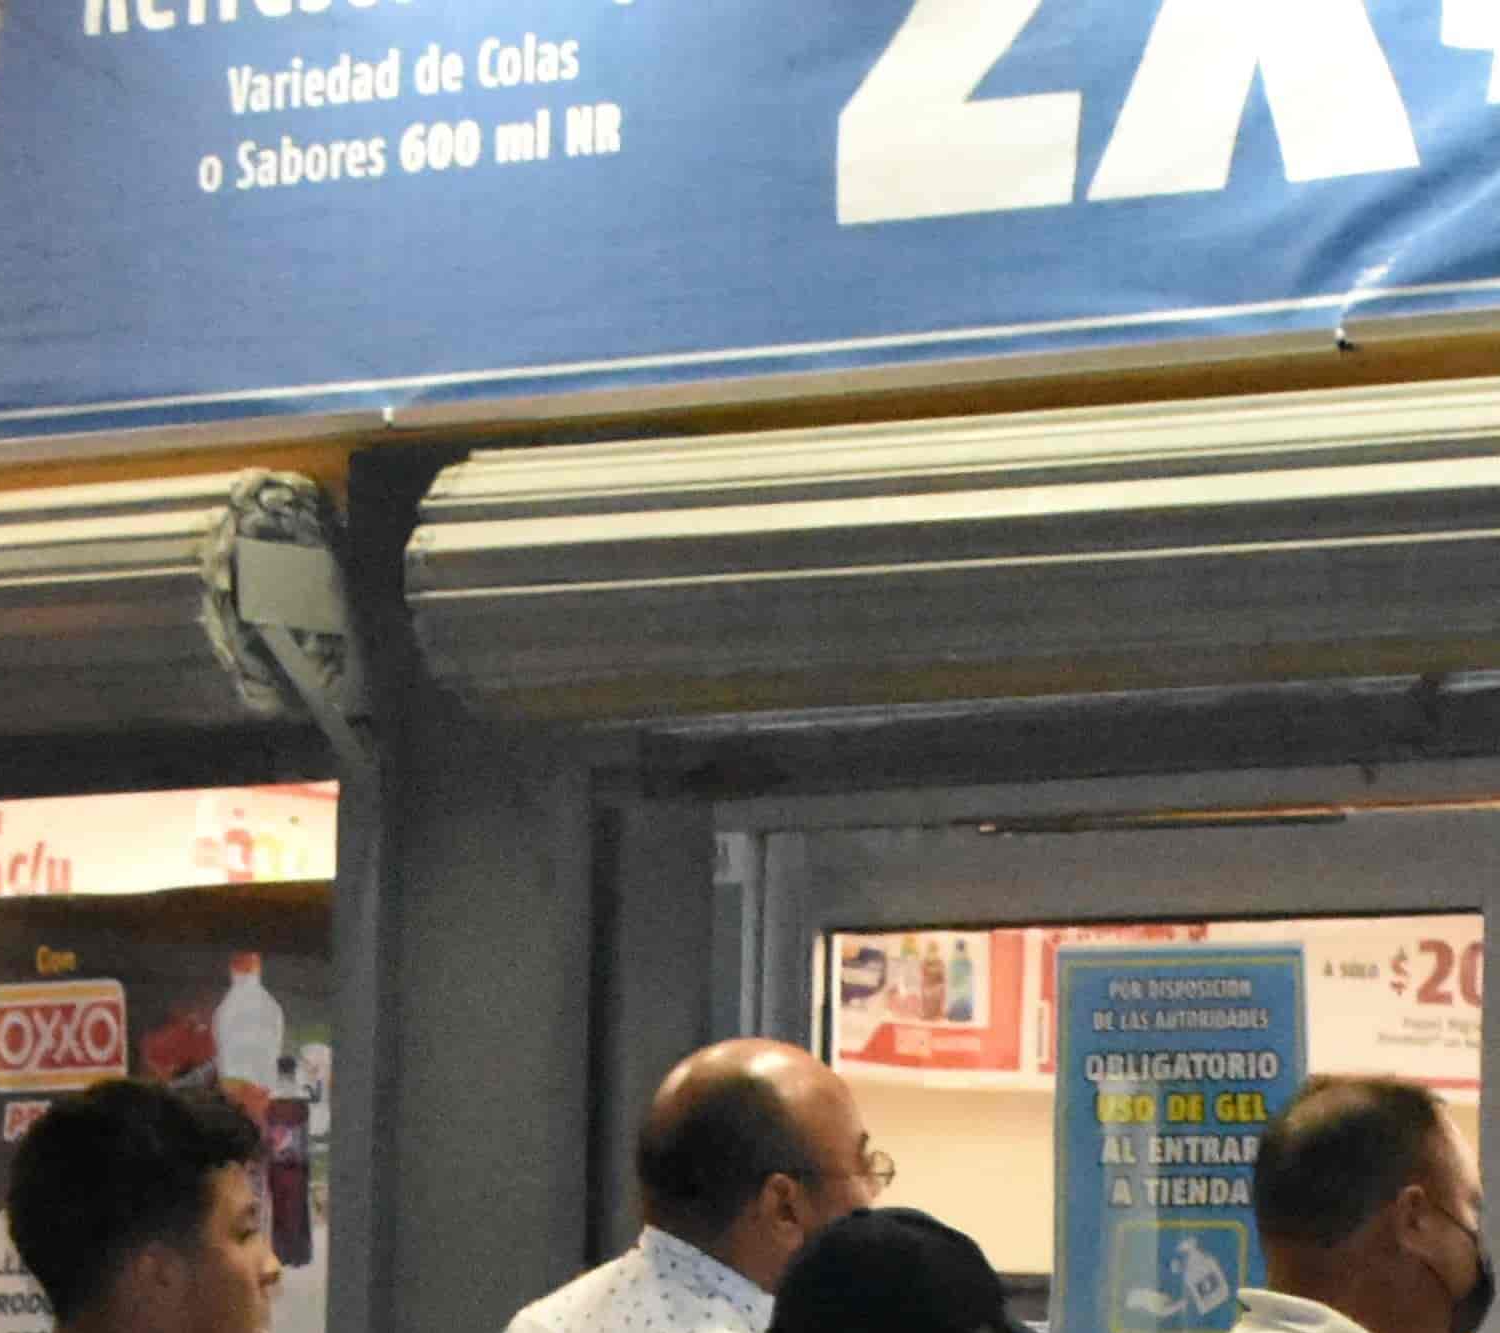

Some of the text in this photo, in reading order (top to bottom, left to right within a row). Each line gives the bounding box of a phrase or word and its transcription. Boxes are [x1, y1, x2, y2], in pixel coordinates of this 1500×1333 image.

[228, 33, 579, 115] Variedad de Colas
[199, 102, 622, 192] o Sabores 600 ml NR
[1085, 1052, 1279, 1081] OBLIGATORIO
[1097, 1092, 1268, 1122] USO DE GEL
[1102, 1135, 1137, 1164] AL
[1111, 1177, 1250, 1205] A TIENDA
